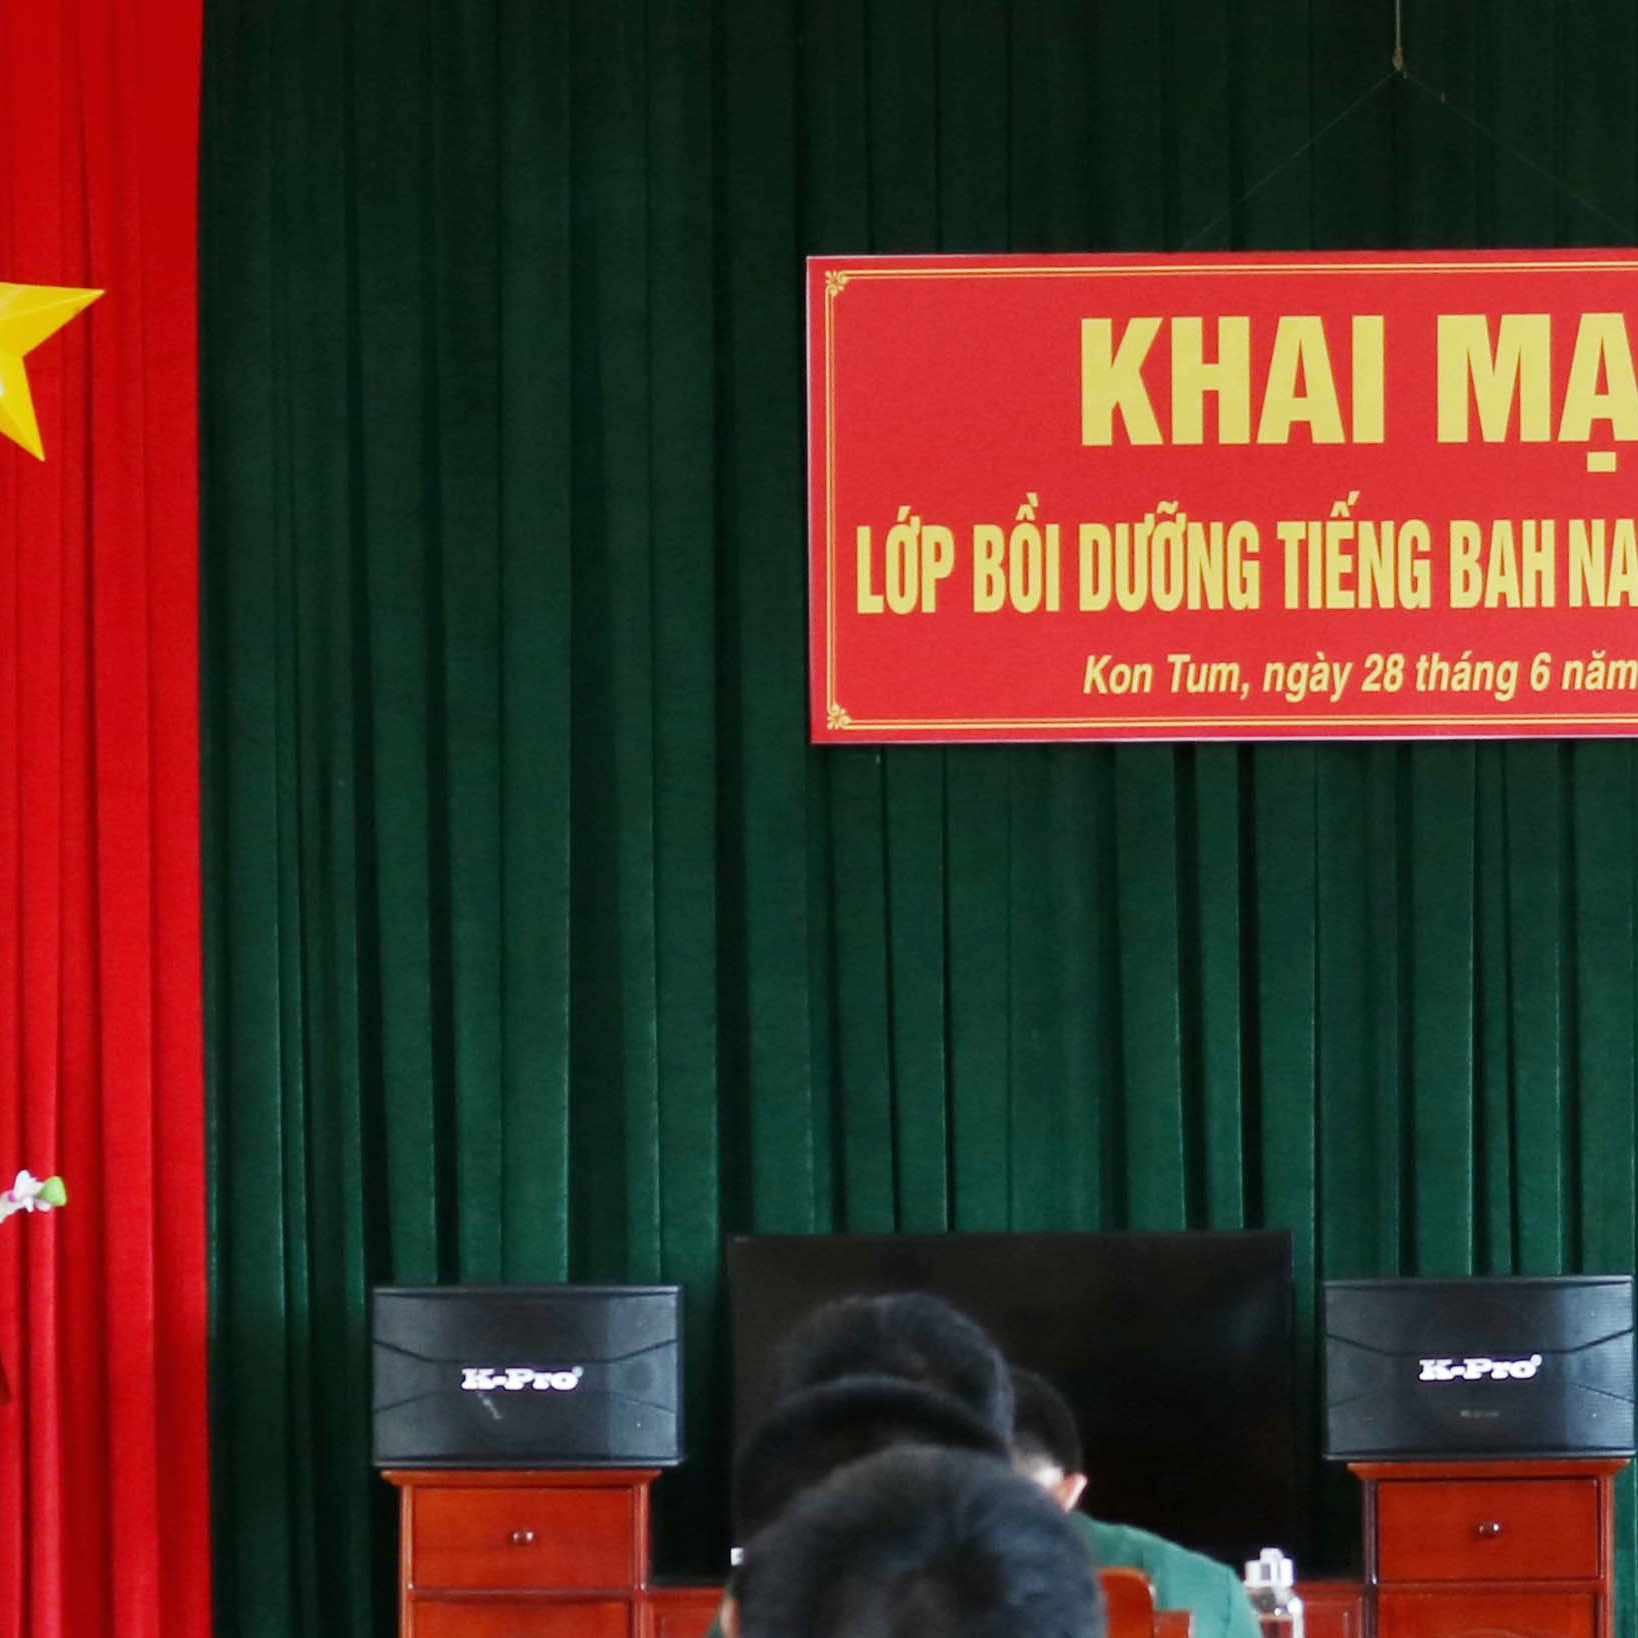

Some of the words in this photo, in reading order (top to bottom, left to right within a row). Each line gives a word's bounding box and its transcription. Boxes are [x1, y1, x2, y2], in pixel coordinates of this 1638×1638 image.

[1080, 314, 1386, 447] KHAI
[856, 505, 956, 615] LỚP
[972, 491, 1061, 614] BỒI
[1078, 500, 1261, 613] DƯỠNG
[1276, 490, 1433, 611] TIẾNG
[1449, 518, 1558, 609] BAH
[1082, 654, 1154, 695] Kon
[1166, 653, 1250, 701] Tum,
[1262, 651, 1354, 704] ngày
[1362, 653, 1406, 693] 28
[1415, 649, 1520, 703] tháng
[1529, 651, 1554, 692] 6
